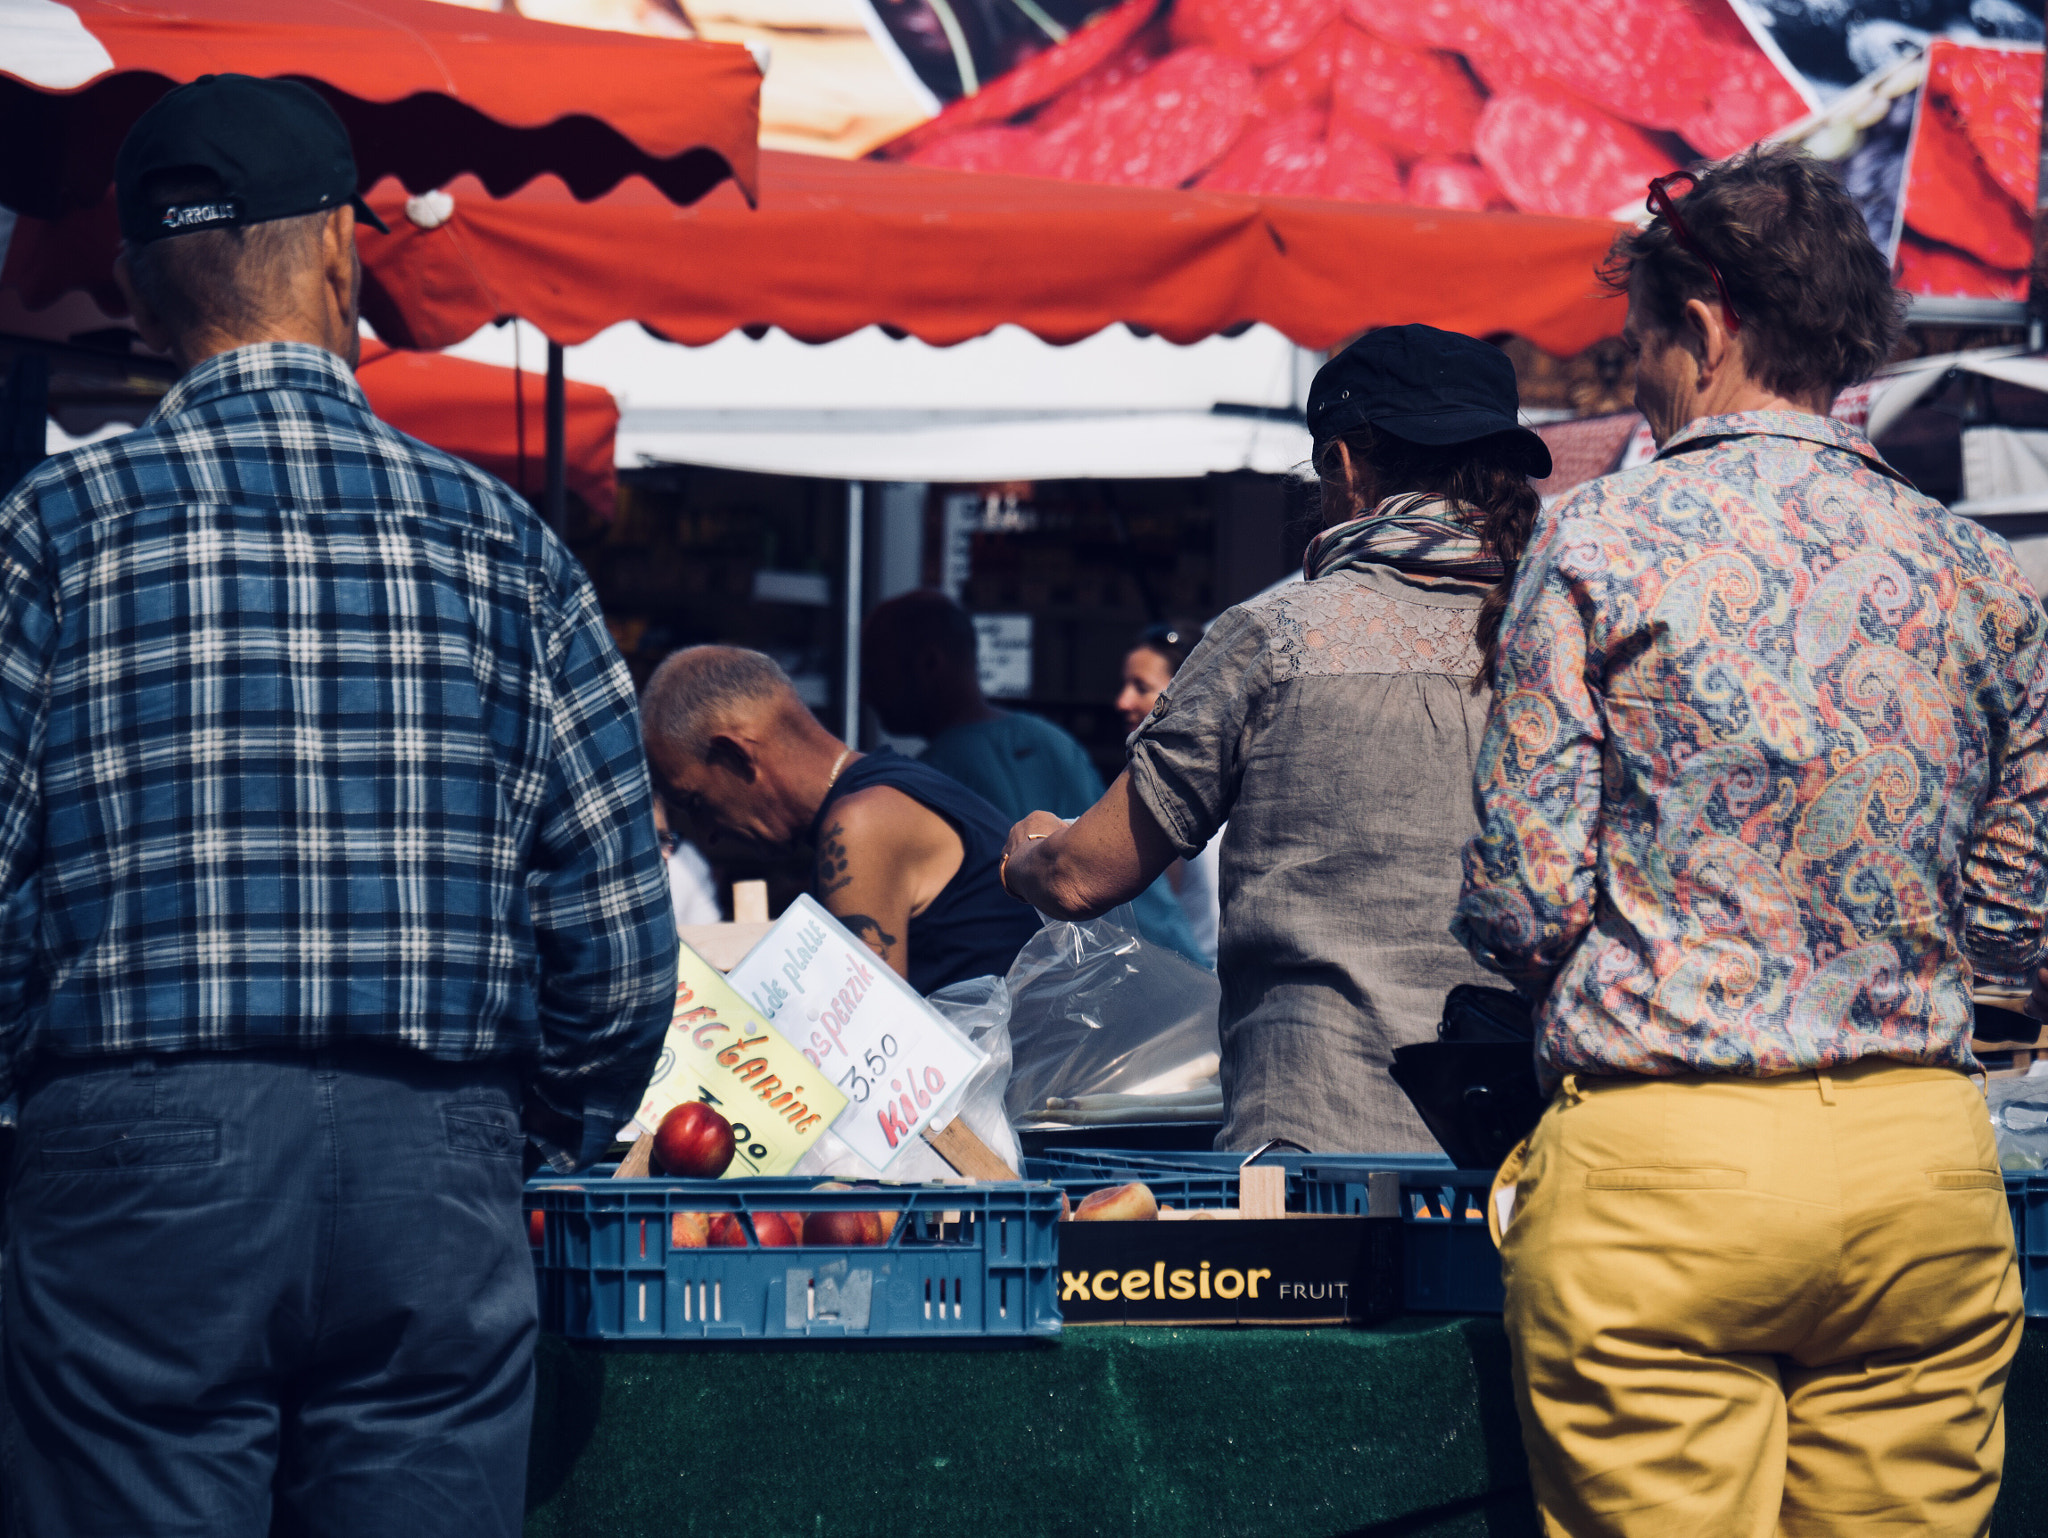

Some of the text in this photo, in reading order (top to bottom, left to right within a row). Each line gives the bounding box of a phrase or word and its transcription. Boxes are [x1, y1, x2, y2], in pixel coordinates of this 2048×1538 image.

[837, 1033, 898, 1103] 3.50
[1057, 1261, 1349, 1301] xcelsior FRUIT
